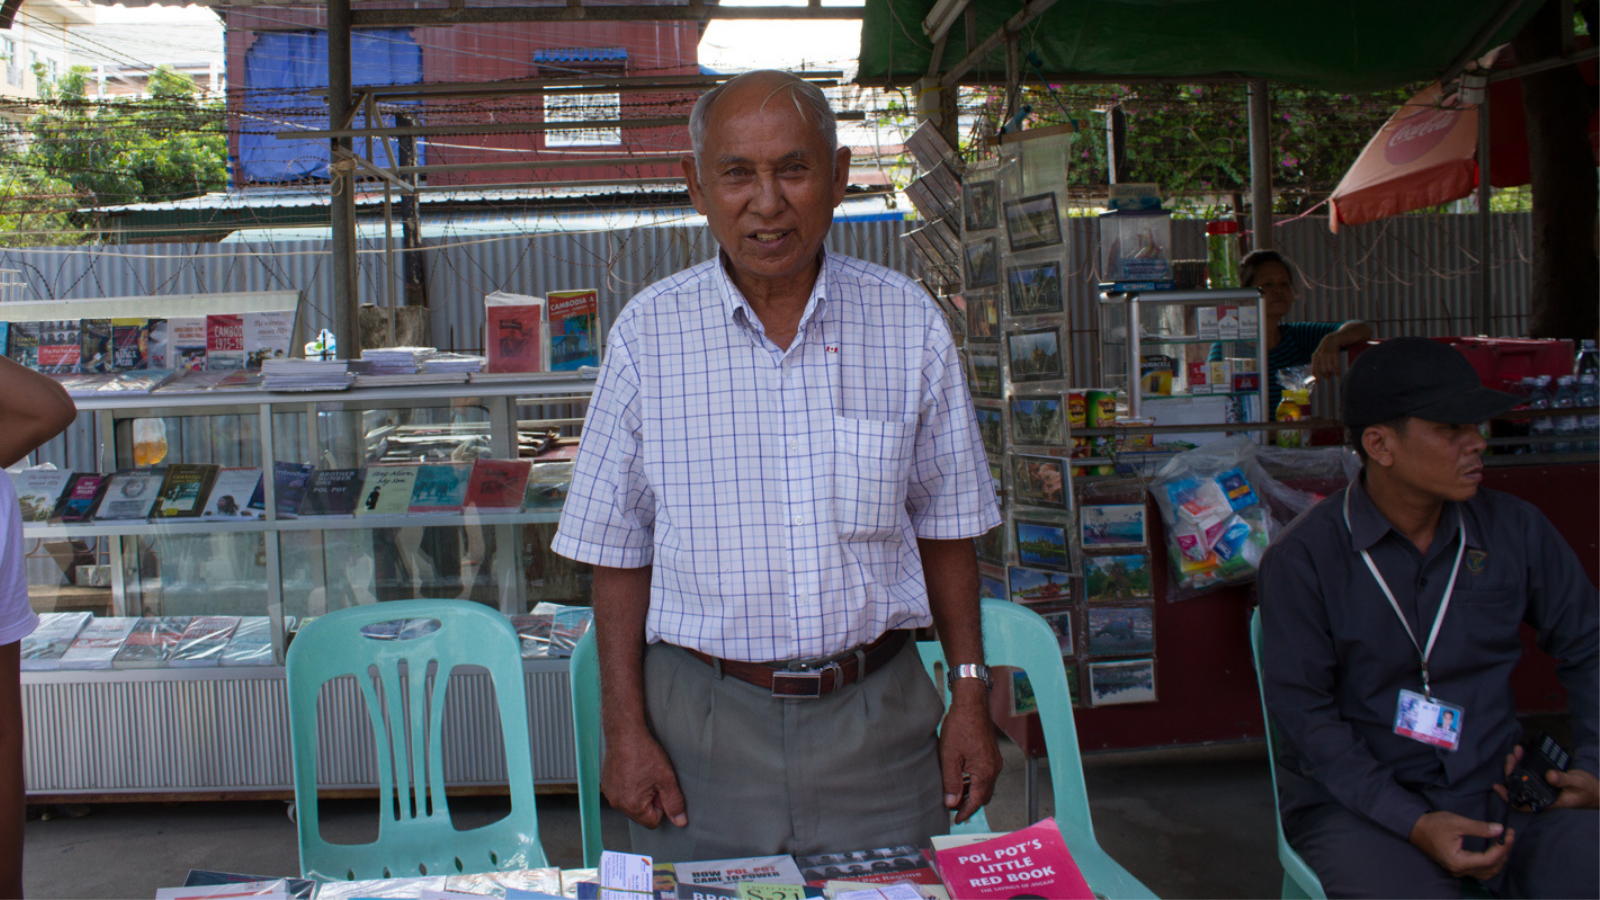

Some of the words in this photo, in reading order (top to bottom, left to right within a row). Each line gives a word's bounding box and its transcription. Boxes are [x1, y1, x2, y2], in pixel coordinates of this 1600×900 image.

[550, 297, 587, 312] CAMBODIA
[214, 325, 243, 338] CAMBOD
[215, 338, 243, 350] 1975-19
[275, 469, 310, 479] mbodge
[957, 853, 992, 865] POL
[994, 838, 1043, 860] POT'S
[691, 870, 721, 878] HOW
[753, 865, 776, 873] POT
[978, 856, 1035, 874] LITTLE
[692, 876, 723, 884] CAME
[741, 871, 781, 879] POWER
[862, 875, 881, 883] Pot
[882, 871, 922, 881] Regime
[969, 875, 1003, 888] RED
[1006, 865, 1056, 883] BOOK
